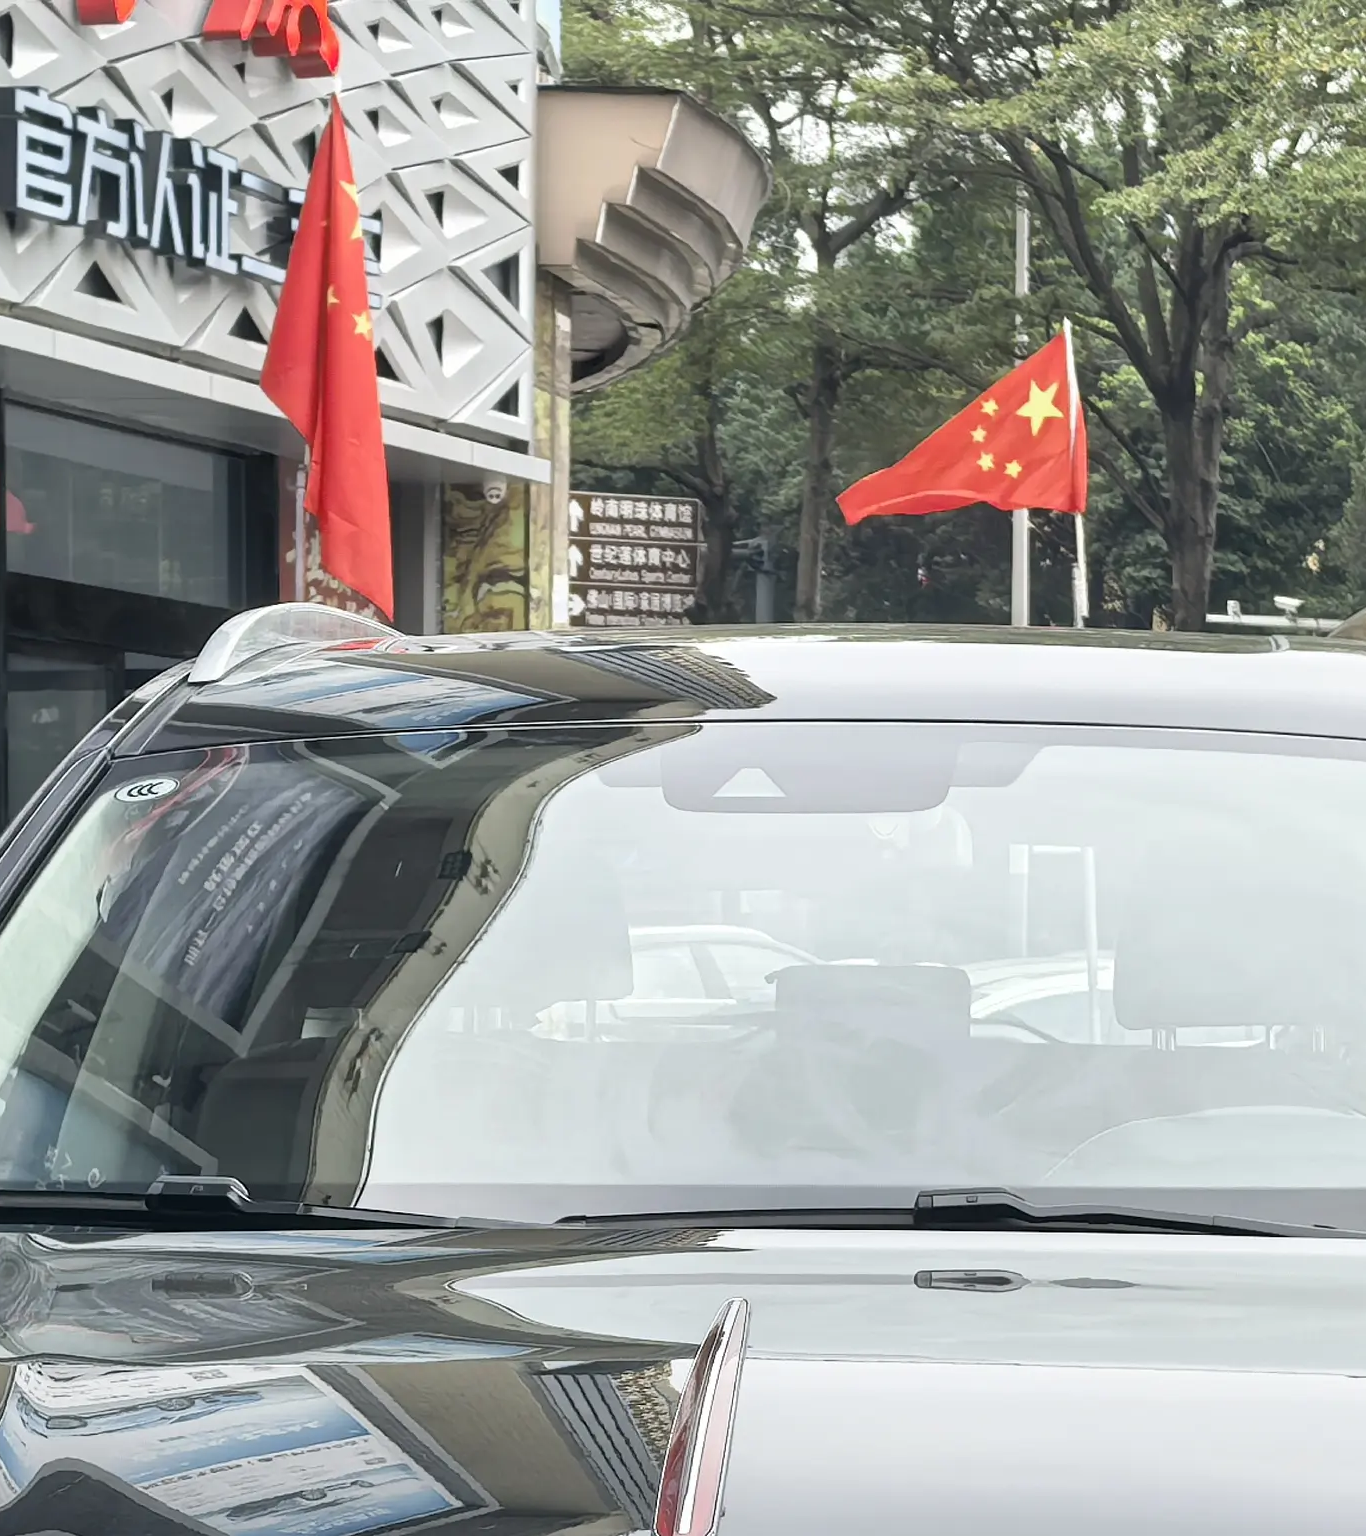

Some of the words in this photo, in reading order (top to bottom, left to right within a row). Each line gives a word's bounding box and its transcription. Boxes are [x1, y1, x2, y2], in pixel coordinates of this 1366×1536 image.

[11, 86, 383, 310] 官方认证二
